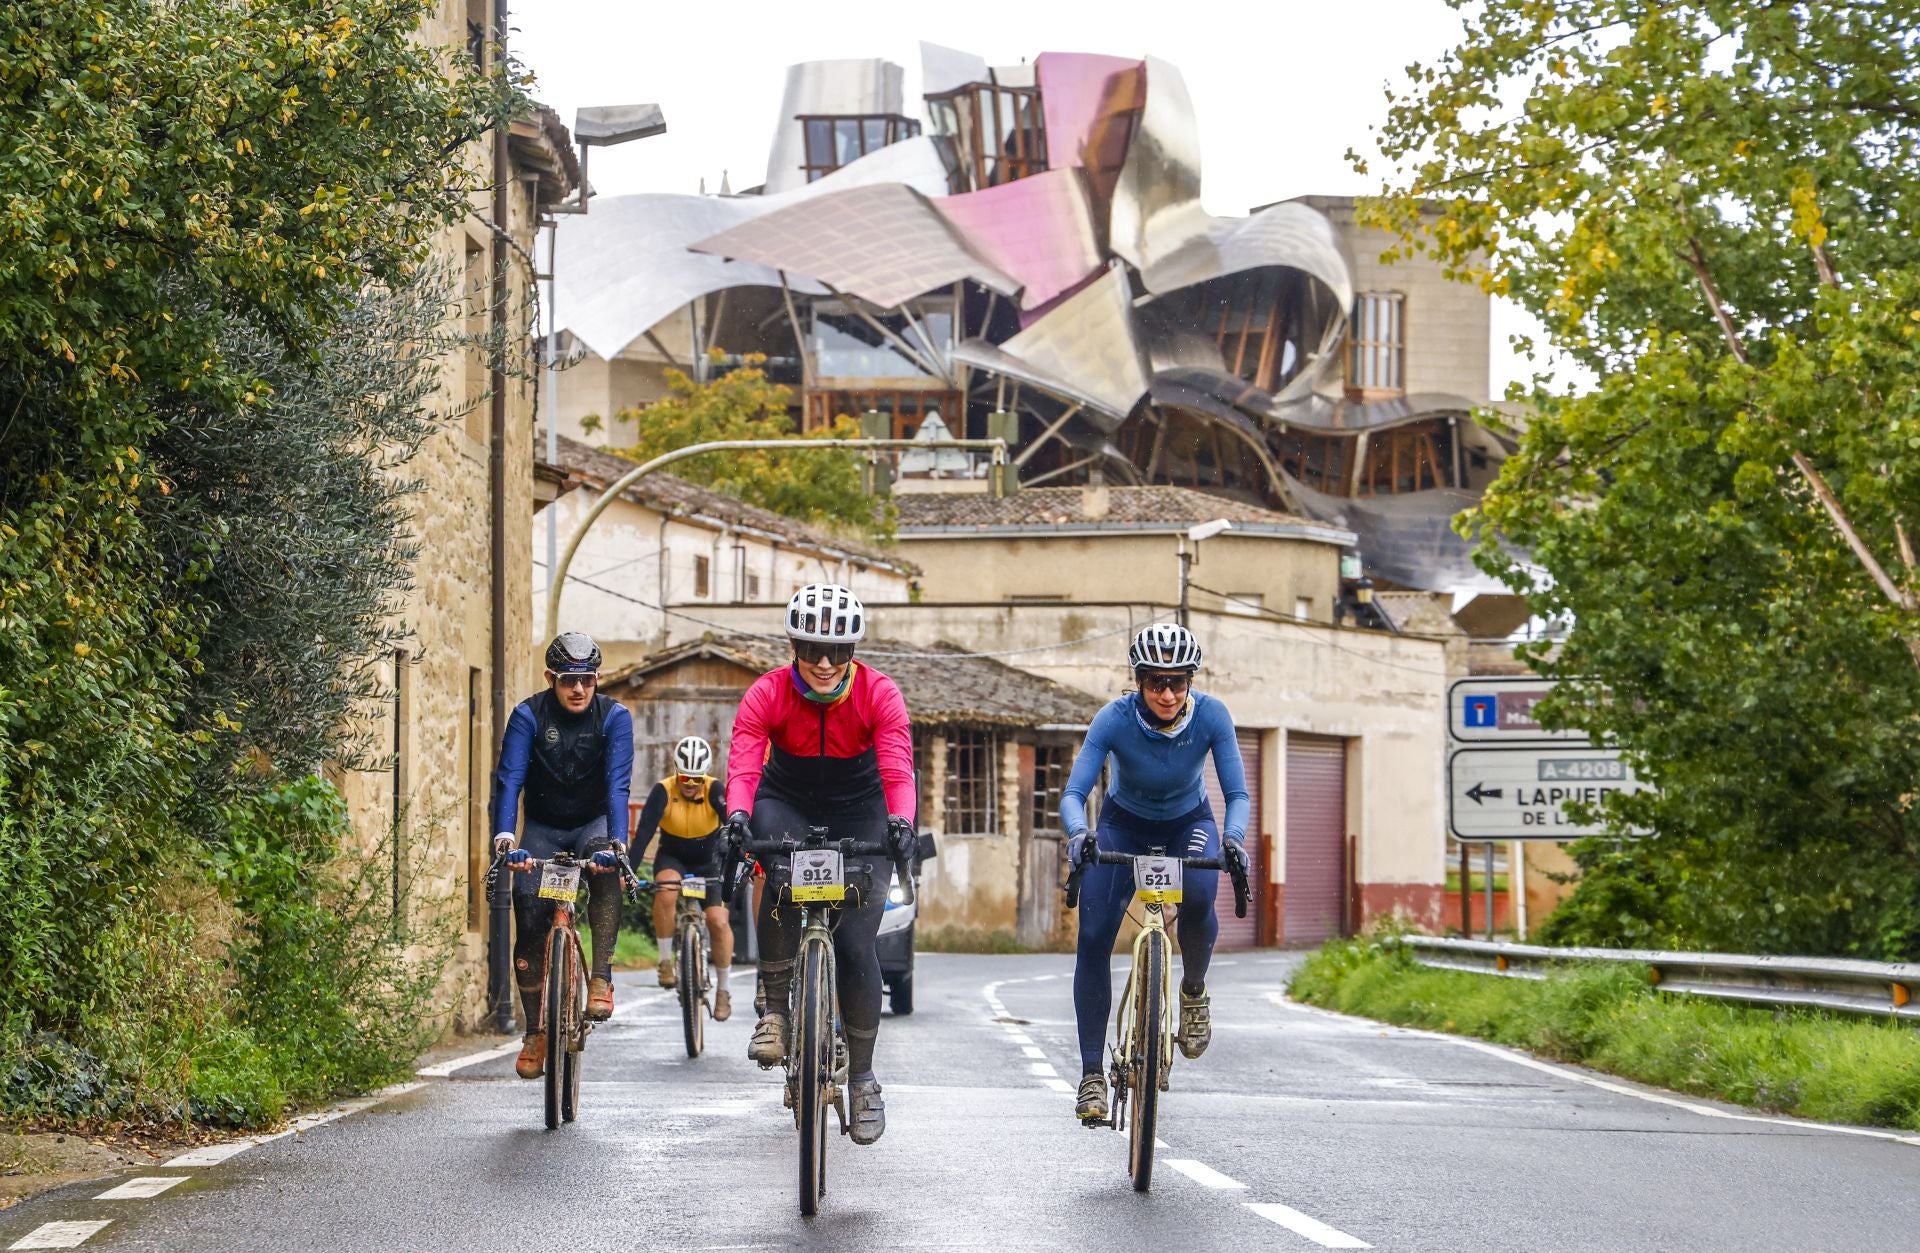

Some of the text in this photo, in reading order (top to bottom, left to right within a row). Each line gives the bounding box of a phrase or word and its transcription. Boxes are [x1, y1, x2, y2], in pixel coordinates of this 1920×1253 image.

[1543, 762, 1622, 778] A-4208
[1517, 788, 1645, 806] LAPUE
[1522, 812, 1546, 825] DE
[803, 868, 832, 881] 912
[1145, 874, 1172, 886] 521
